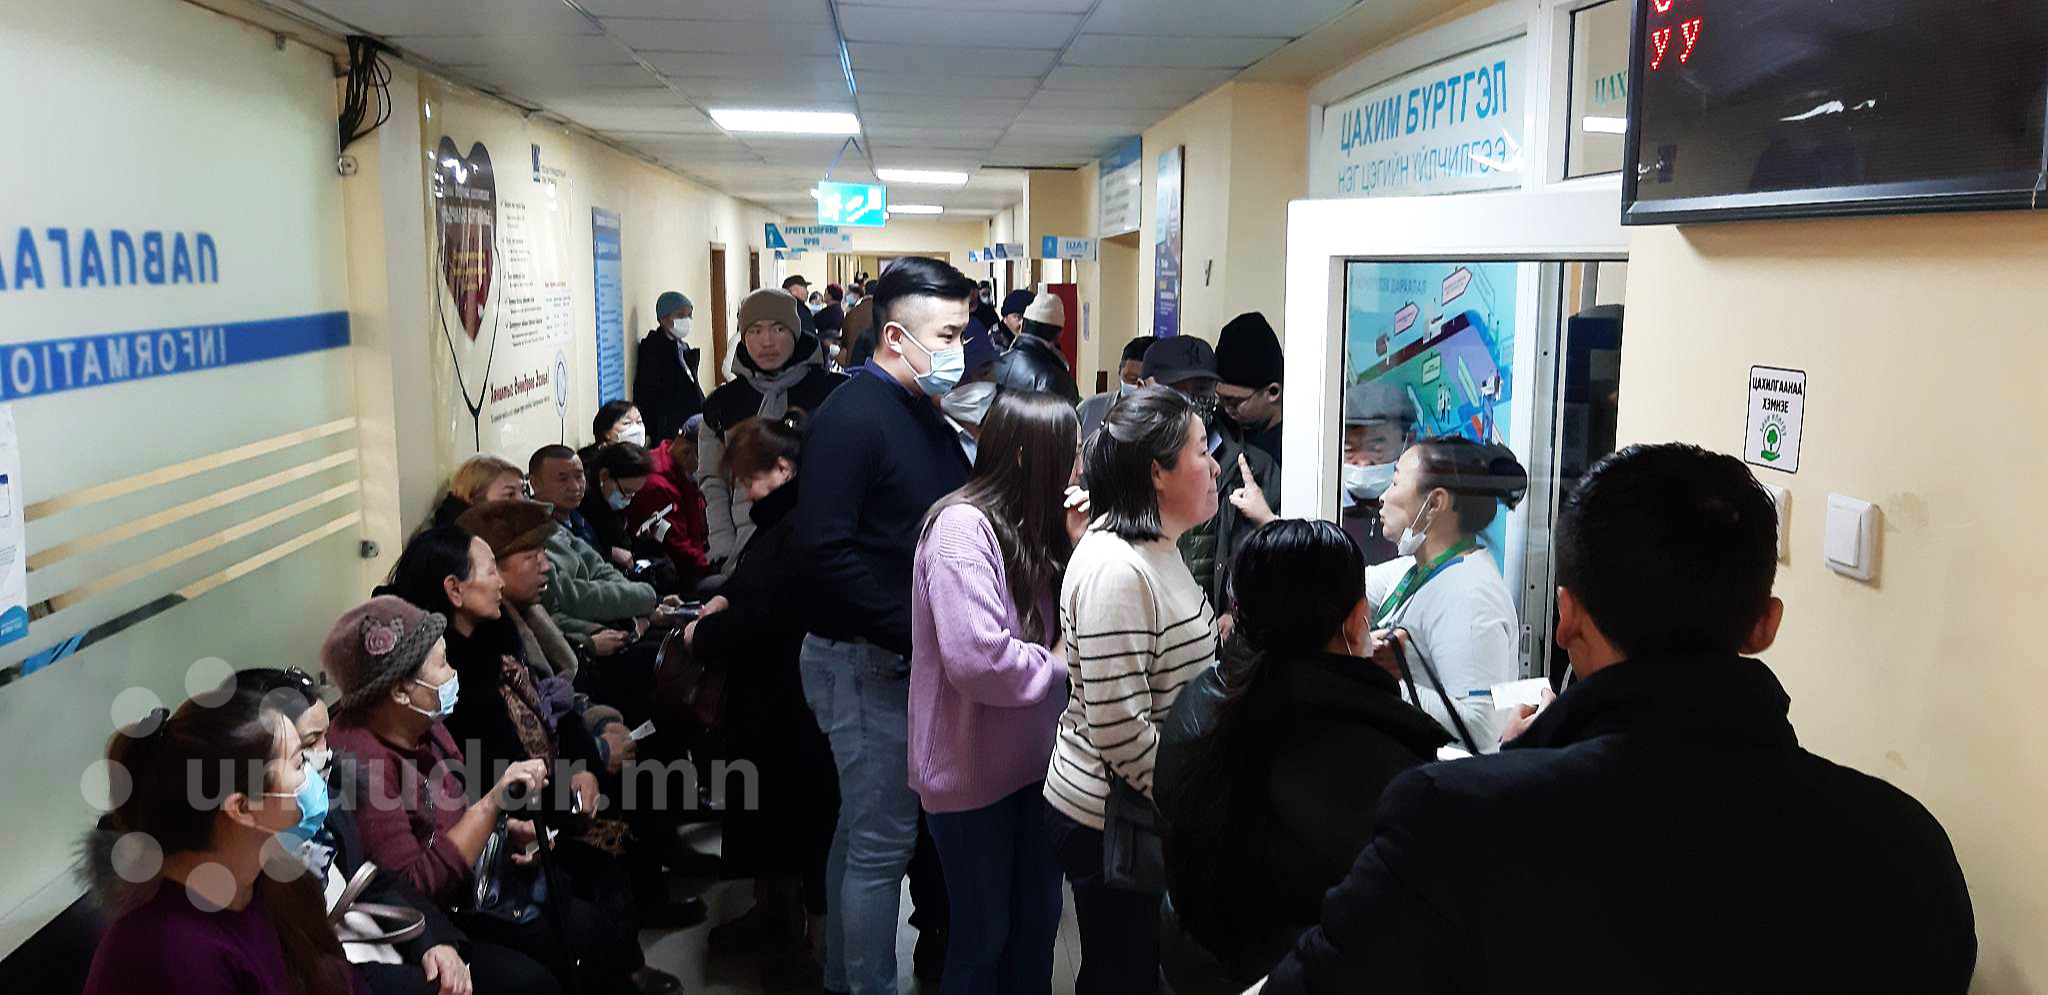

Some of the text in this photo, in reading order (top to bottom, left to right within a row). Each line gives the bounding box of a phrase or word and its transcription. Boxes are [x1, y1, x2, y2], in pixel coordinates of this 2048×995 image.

[1341, 60, 1508, 157] ЦАХИМ БҮРТГЭЛ
[1338, 137, 1507, 196] НЭГ ЦЭГИЙН ҮЙЛЧИЛГЭЭ
[1752, 377, 1803, 396] ЦАХИЛГААНАА
[1761, 398, 1789, 414] ХЭМНЭЕ
